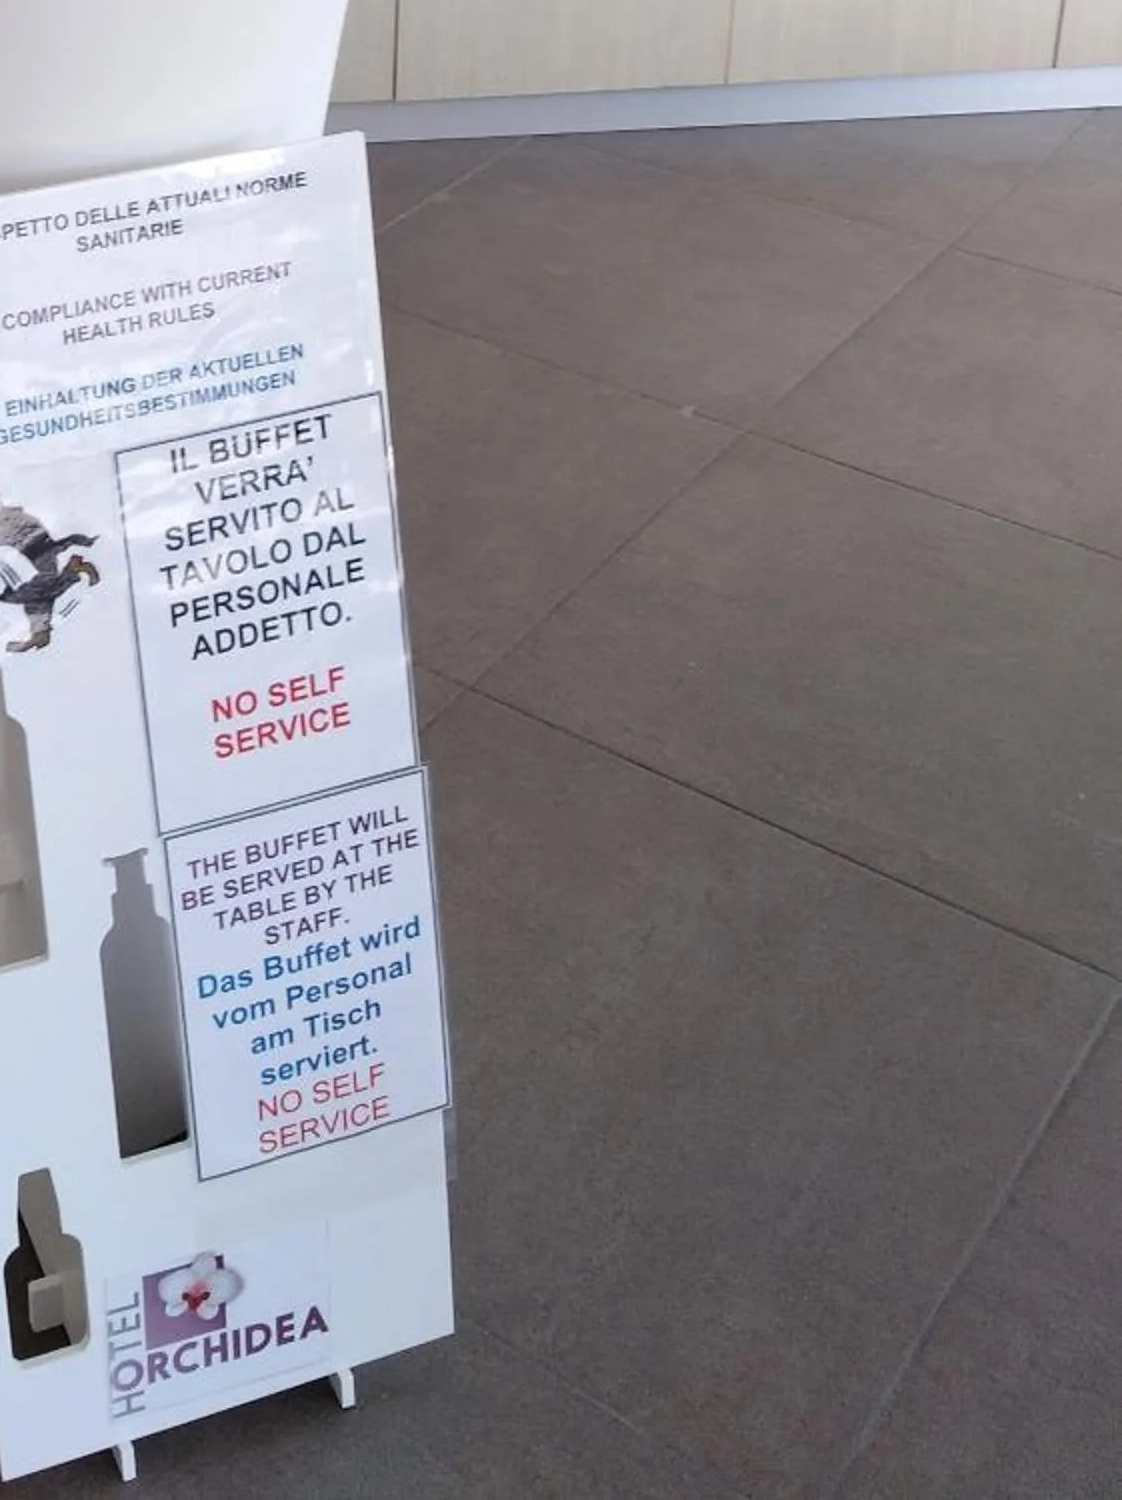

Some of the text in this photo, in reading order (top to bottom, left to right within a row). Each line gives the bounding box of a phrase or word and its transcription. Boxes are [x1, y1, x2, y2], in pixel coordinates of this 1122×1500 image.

[75, 201, 139, 229] DELLE
[145, 187, 231, 217] ATTUALI
[237, 172, 307, 198] NORME
[76, 220, 183, 253] SANITARIE
[2, 291, 135, 331] COMPLIANCE
[141, 281, 191, 304] WITH
[198, 262, 291, 293] CURRENT
[63, 302, 215, 345] HEALTH RULES
[5, 377, 136, 417] EINHALTUNG
[141, 367, 183, 391] DER
[189, 343, 304, 383] AKTUELLEN
[170, 414, 332, 473] IL BUFFET
[195, 456, 314, 505] VERRA'
[165, 487, 354, 551] SERVITO AL
[160, 523, 365, 591] TAVOLO DAL
[170, 558, 364, 628] PERSONALE
[192, 601, 352, 660] ADDETTO.
[211, 666, 345, 722] NO SELF
[214, 702, 351, 758] SERVICE
[181, 829, 419, 910] BE SERVED AT THE
[187, 805, 409, 880] THE BUFFET WILL
[213, 865, 393, 931] TABLE BY THE
[264, 908, 350, 945] STAFF.
[198, 916, 421, 998] Das Buffet wird
[212, 953, 411, 1029] vom Personal
[251, 998, 381, 1055] am Tisch
[261, 1035, 378, 1086] serviert.
[257, 1063, 385, 1121] NO SELF
[259, 1096, 391, 1154] SERVICE
[108, 1291, 146, 1419] HOTEL
[111, 1306, 329, 1390] ORCHIDEA
